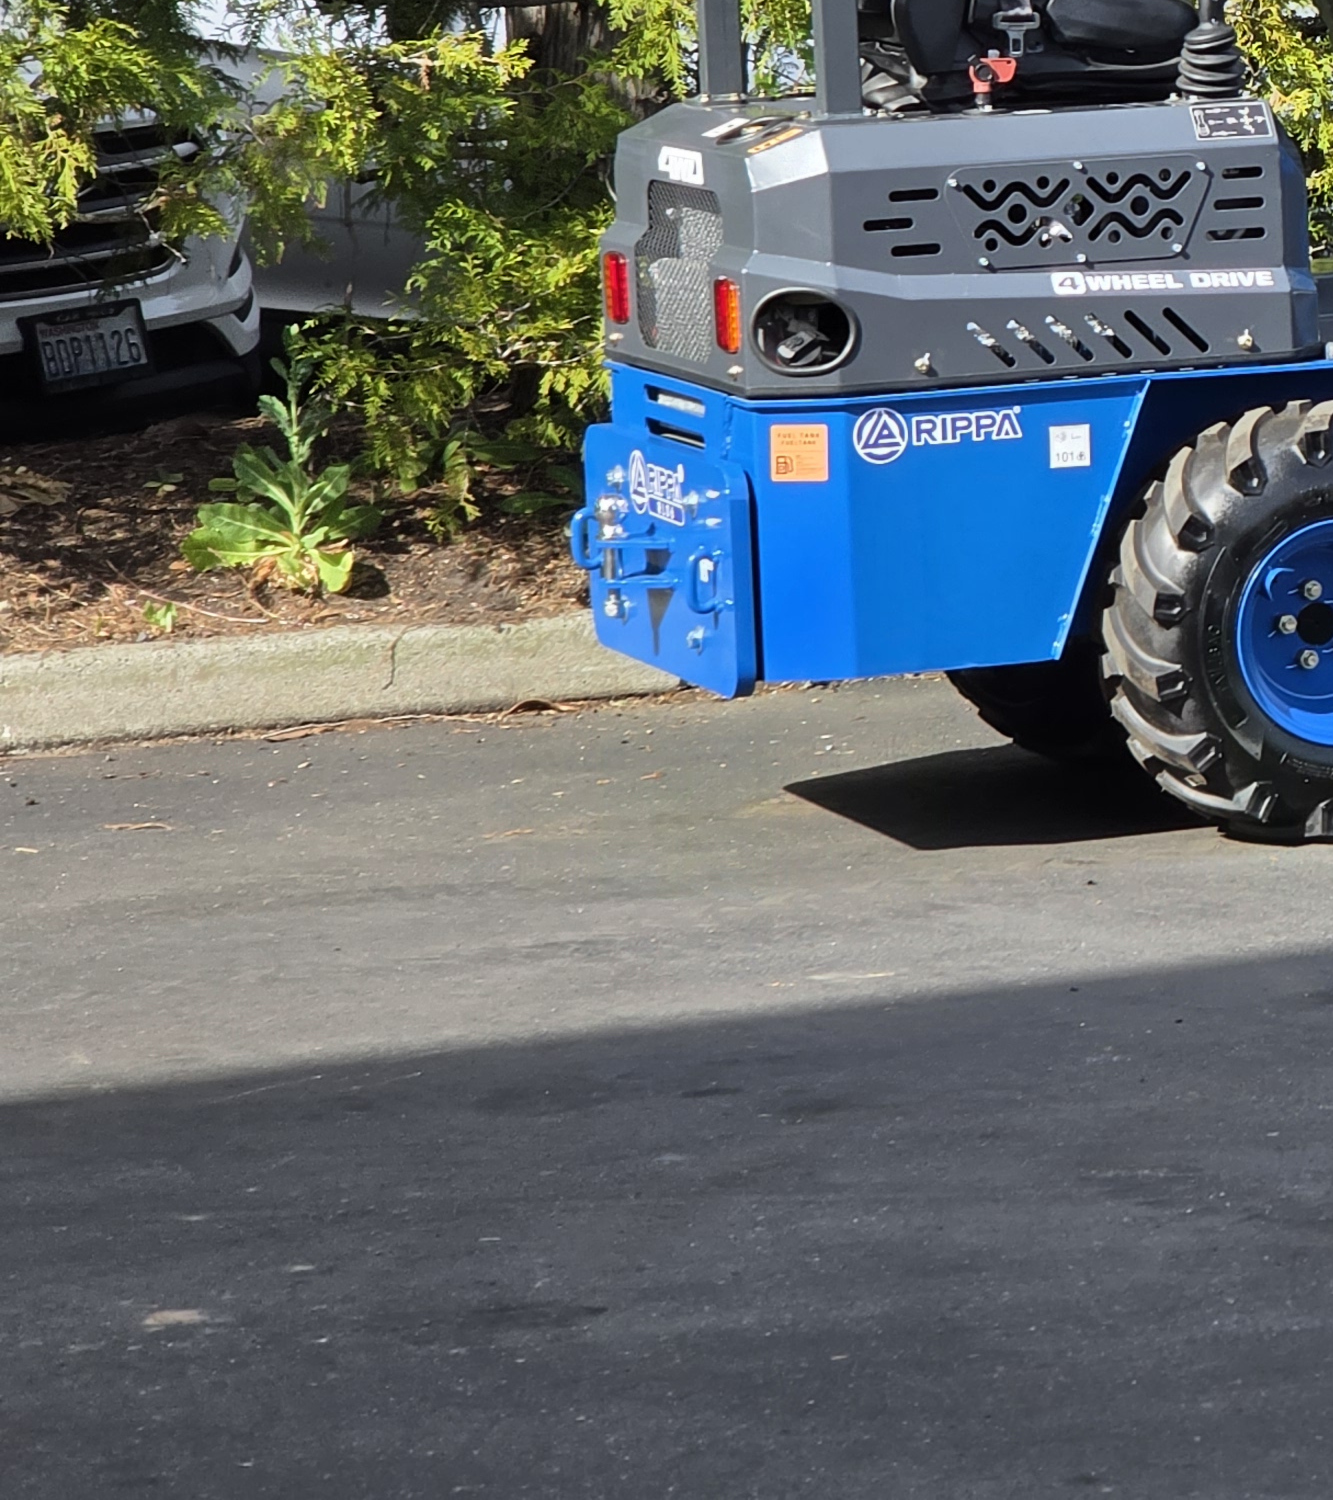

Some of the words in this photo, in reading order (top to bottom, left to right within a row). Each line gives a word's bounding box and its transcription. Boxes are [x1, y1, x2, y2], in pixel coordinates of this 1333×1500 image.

[1085, 273, 1184, 292] WHEEL
[1189, 270, 1275, 288] DRIVE
[912, 410, 1023, 446] RIPPA
